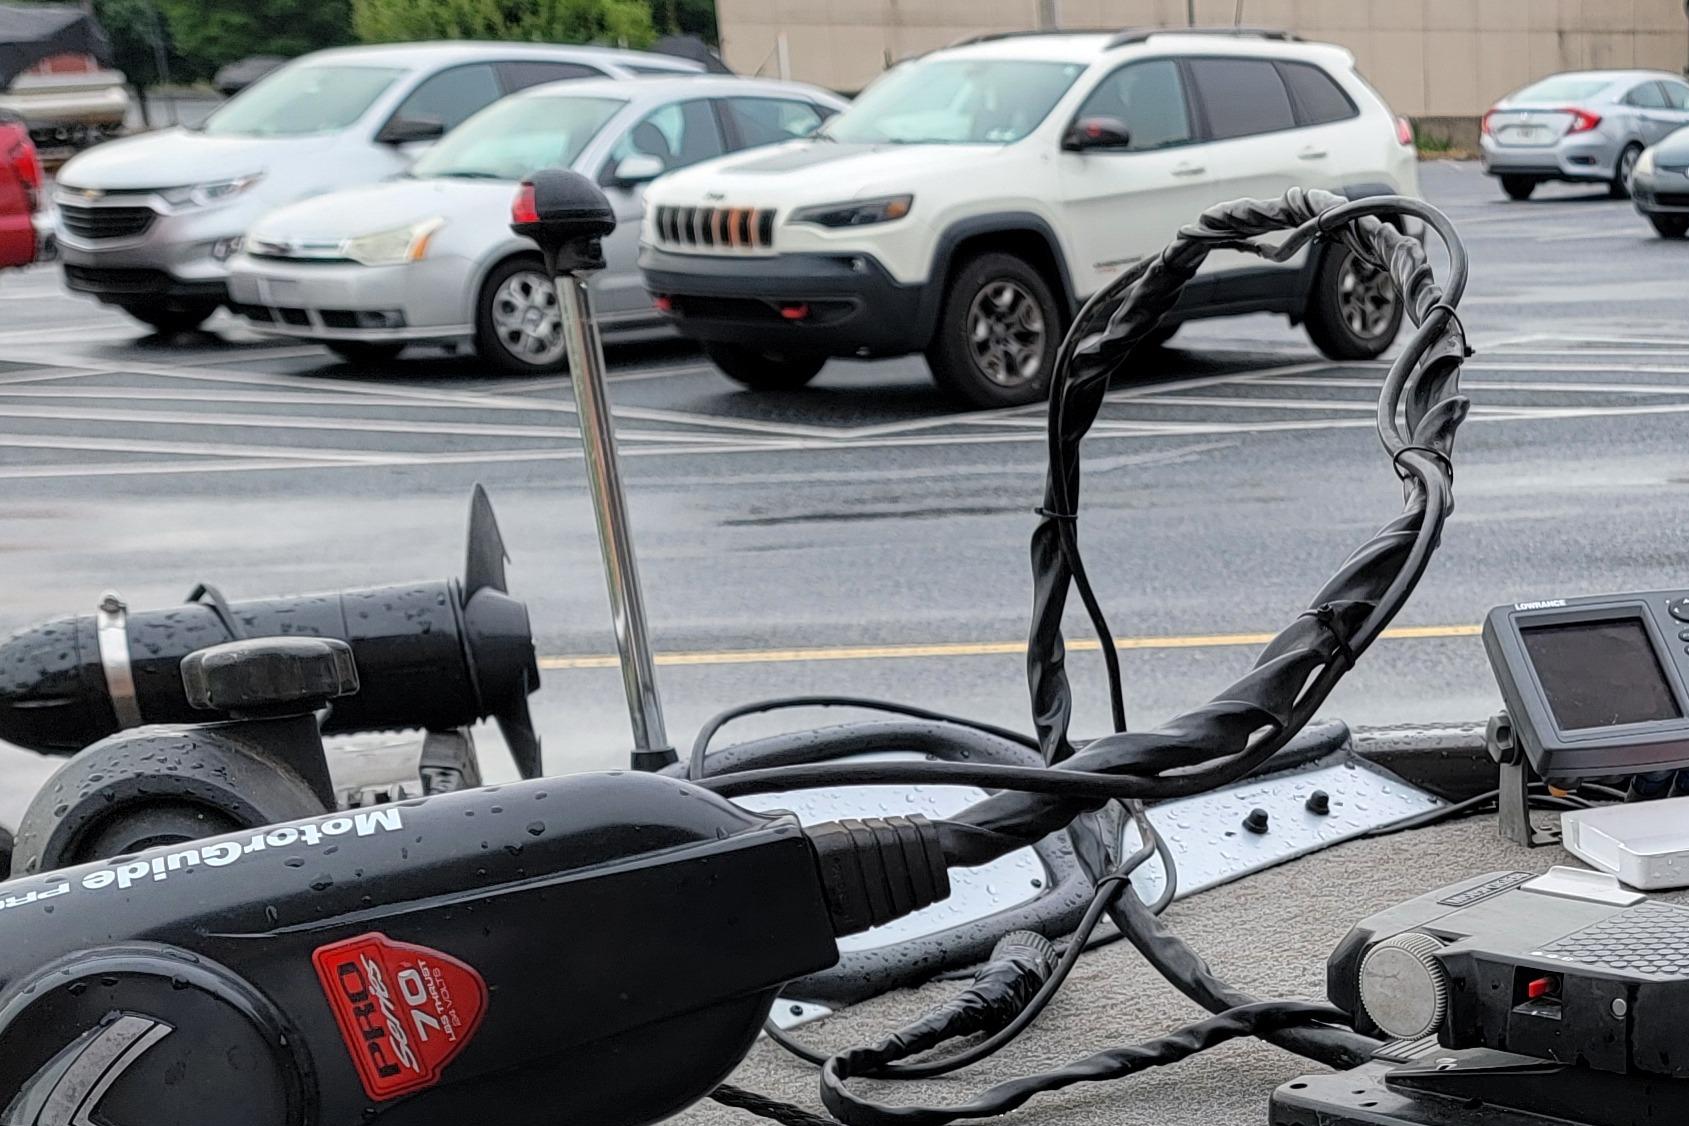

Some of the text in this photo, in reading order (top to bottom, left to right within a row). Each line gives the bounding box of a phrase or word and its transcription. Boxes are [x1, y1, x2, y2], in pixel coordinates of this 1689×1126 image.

[1514, 599, 1566, 611] LOWRANCE
[0, 808, 404, 911] MotorGuide PR
[336, 961, 400, 1078] PRO
[360, 953, 420, 1073] Series
[397, 968, 441, 1042] 70
[417, 958, 457, 1042] LBS THRUST
